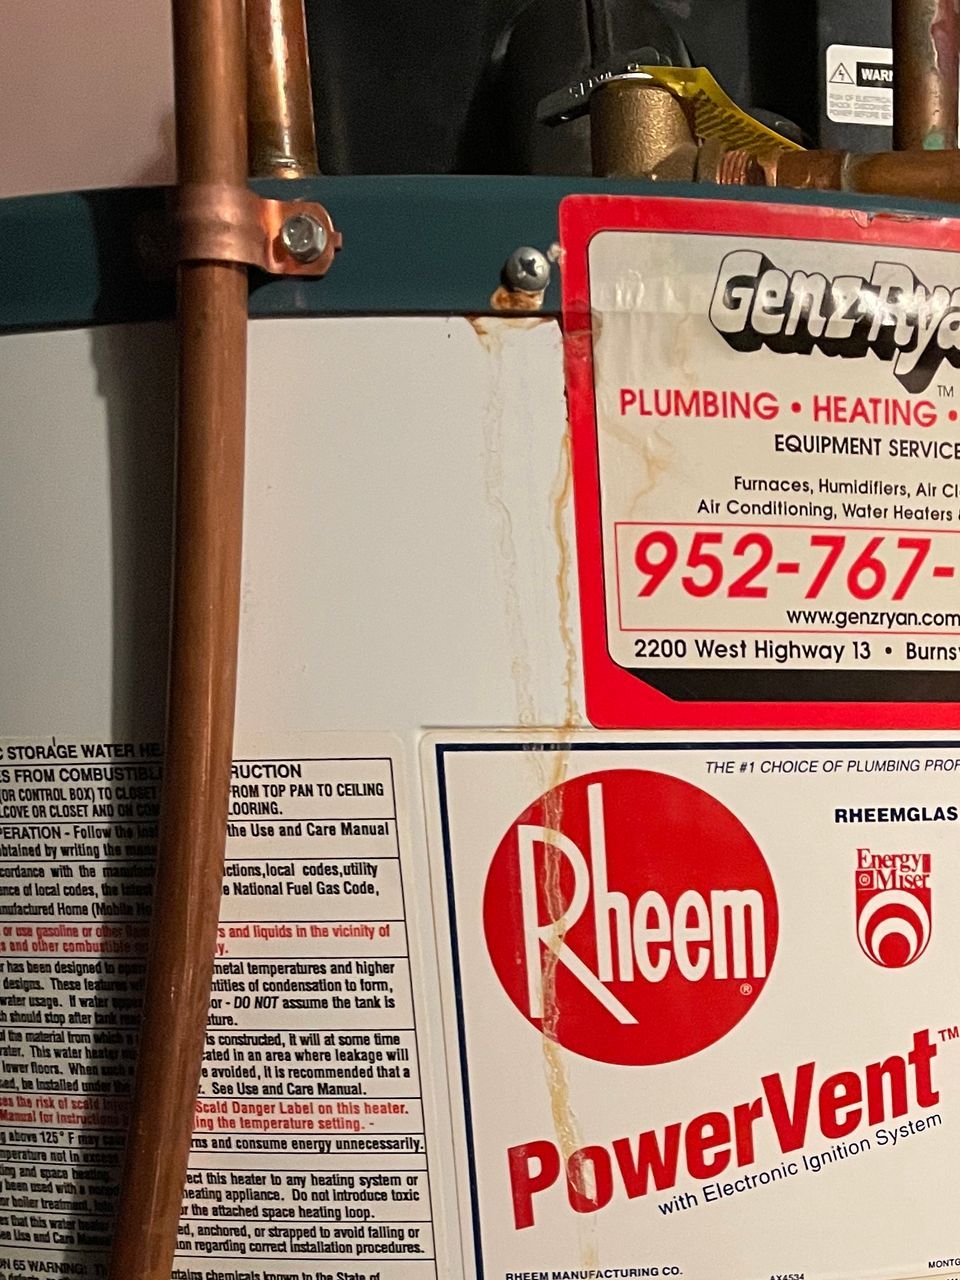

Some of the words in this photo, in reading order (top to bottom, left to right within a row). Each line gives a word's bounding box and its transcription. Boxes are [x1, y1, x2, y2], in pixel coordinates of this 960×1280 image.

[620, 388, 779, 420] PLUMBING
[813, 395, 937, 427] HEATING
[775, 434, 882, 456] EQUIPMENT
[734, 476, 814, 495] Furnaces,
[819, 478, 910, 498] Humidifiers,
[916, 482, 937, 497] Air
[697, 499, 720, 514] Air
[726, 500, 837, 521] Conditioning,
[842, 503, 888, 519] Water
[894, 505, 953, 521] Heaters
[786, 610, 960, 629] www.genzryan.com
[634, 639, 687, 658] 2200
[694, 639, 747, 658] West
[755, 640, 845, 663] Highway
[852, 641, 871, 660] 13
[706, 761, 735, 774] THE
[739, 761, 755, 773] #1
[760, 760, 819, 773] CHOICE
[822, 760, 844, 773] OF
[847, 759, 920, 773] PLUMBING
[261, 784, 286, 798] TOP
[289, 784, 314, 797] PAN
[316, 783, 333, 797] TO
[336, 783, 384, 797] CEILING
[835, 806, 958, 823] RHEEMGLAS
[856, 848, 922, 873] Energy
[875, 868, 930, 890] Miser
[516, 782, 767, 1025] Rheem
[506, 1028, 940, 1231] PowerVent
[658, 1192, 698, 1215] with
[703, 1162, 798, 1202] Electronic
[802, 1139, 871, 1172] Ignition
[875, 1114, 942, 1146] System
[552, 1267, 659, 1280] MANUFACTURING
[662, 1266, 683, 1276] CO.
